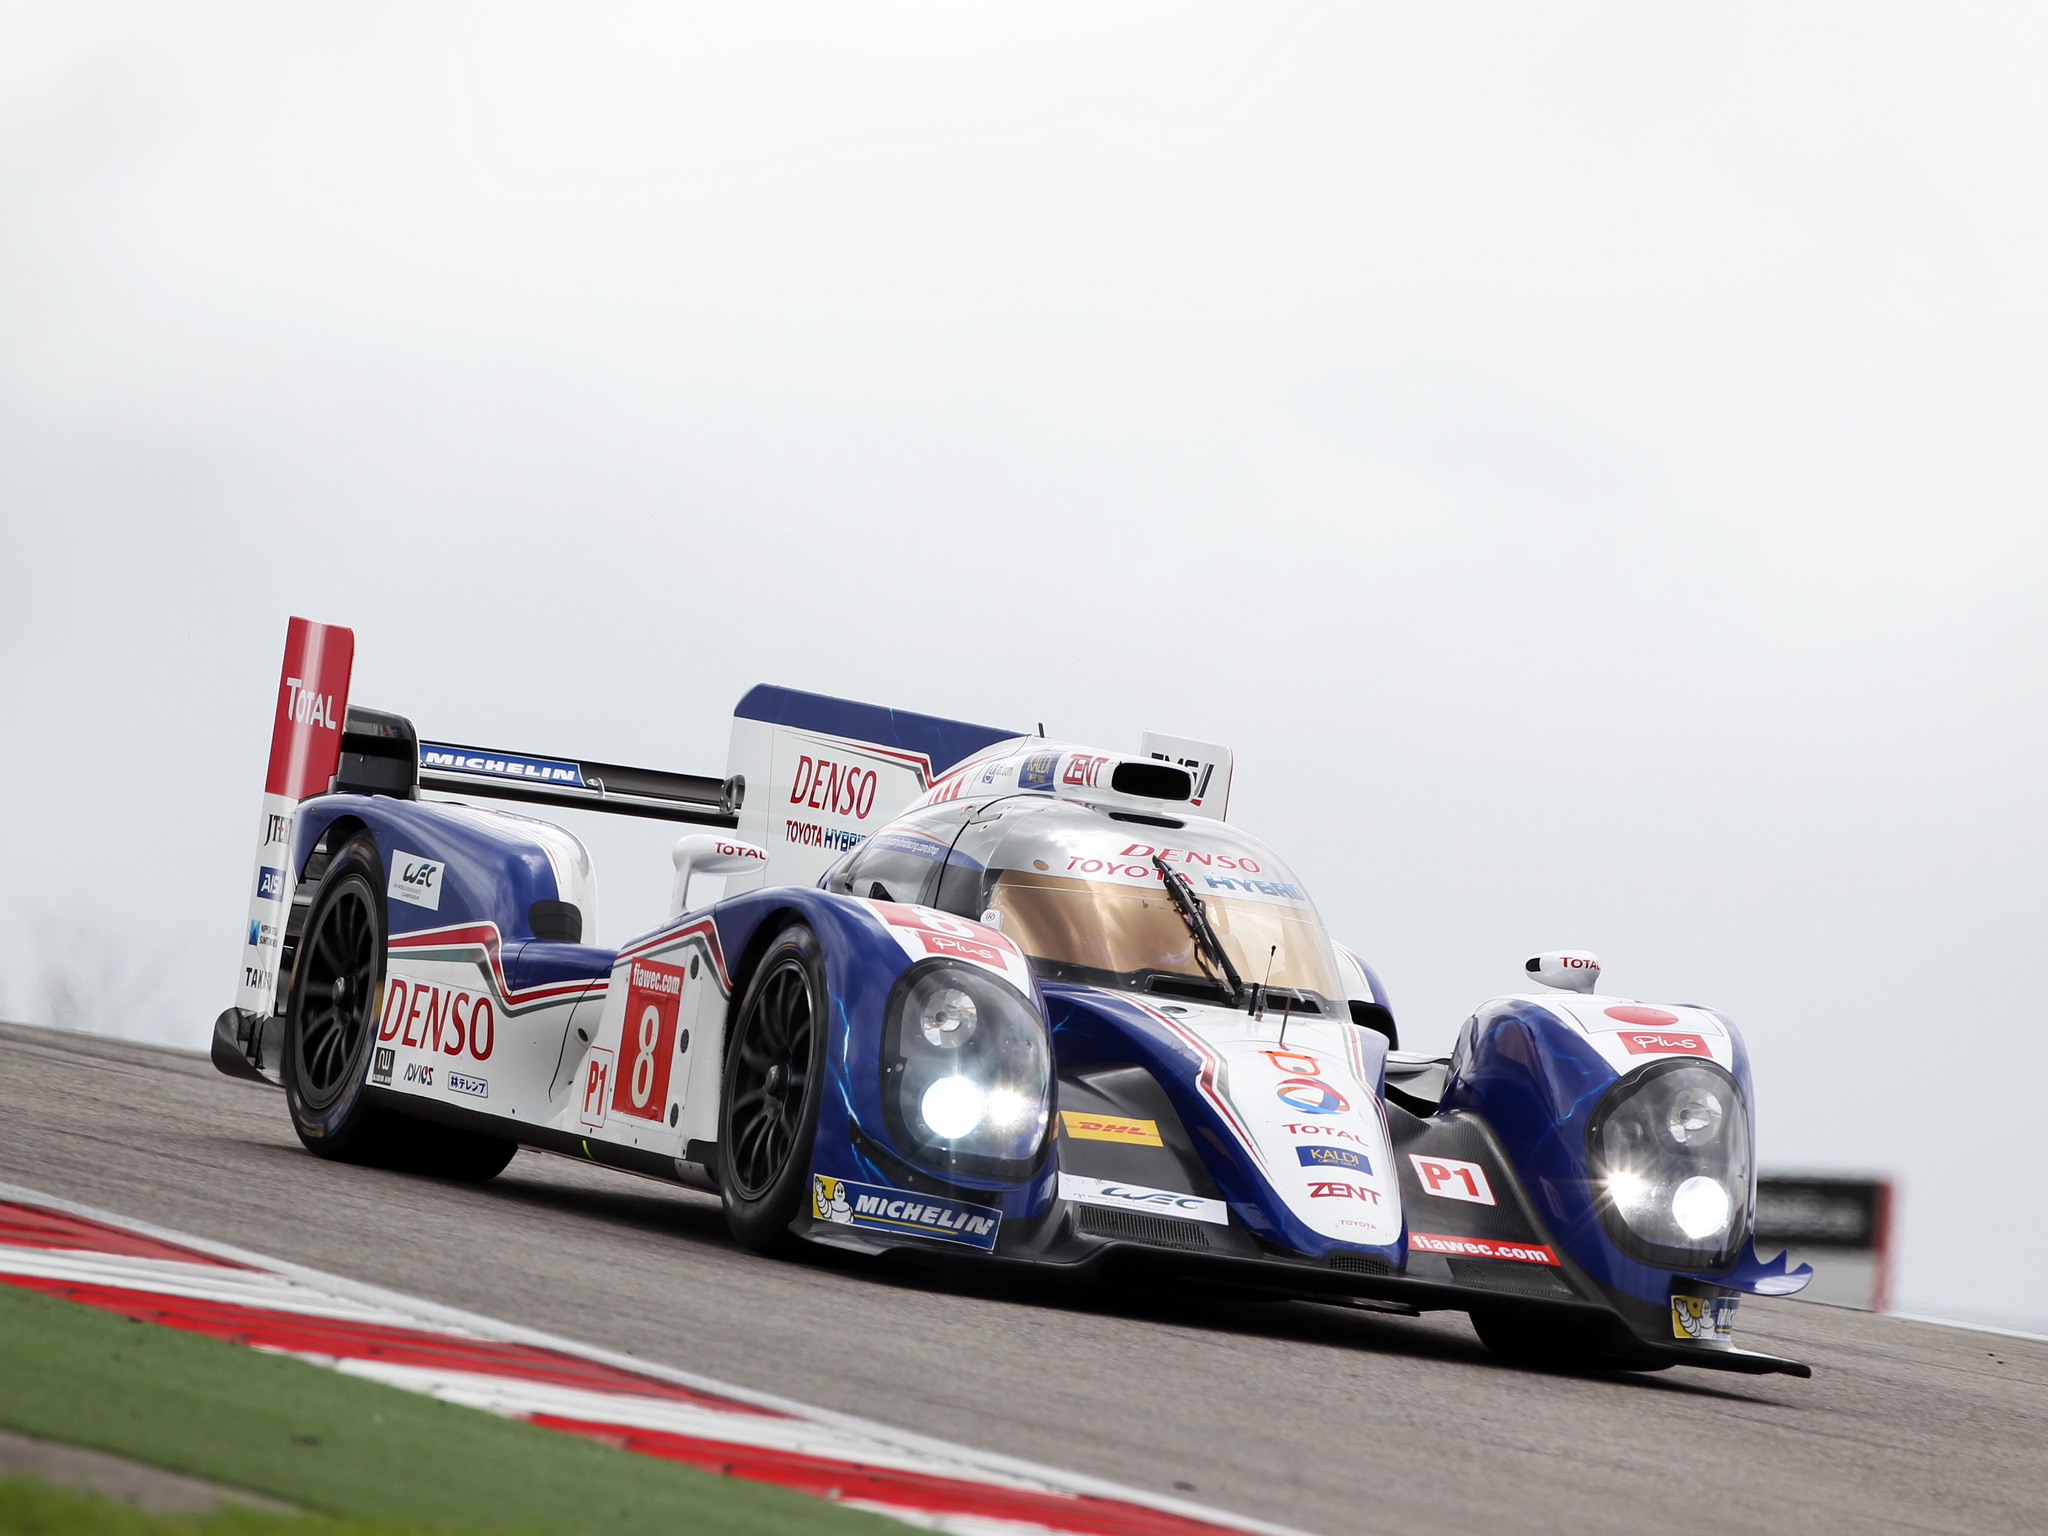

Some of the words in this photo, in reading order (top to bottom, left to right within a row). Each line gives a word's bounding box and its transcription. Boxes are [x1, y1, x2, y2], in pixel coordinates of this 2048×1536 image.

[286, 676, 337, 730] TOTAL
[425, 751, 575, 782] MICHELIN
[1063, 754, 1110, 788] ZENT
[789, 754, 878, 820] DENSO
[785, 819, 823, 848] TOYOTA
[823, 827, 867, 852] HYBR
[715, 841, 767, 861] TOTAL
[1119, 843, 1262, 875] DENSO
[402, 862, 437, 888] WEC
[1203, 875, 1307, 902] HYBRID
[911, 907, 976, 939] 8
[932, 937, 994, 960] Plus
[1559, 956, 1600, 971] TOTAL
[632, 963, 681, 995] fiawec.com
[378, 978, 495, 1061] DENSO
[631, 1004, 660, 1109] 8
[1632, 1034, 1697, 1050] Plus
[583, 1060, 608, 1116] P1
[1078, 1121, 1148, 1136] DHL
[1282, 1123, 1370, 1148] TOTAL
[1310, 1148, 1360, 1165] KALDI
[1307, 1182, 1381, 1206] ZENT
[1419, 1161, 1480, 1198] P1
[1101, 1186, 1204, 1210] WEC
[855, 1194, 996, 1236] MICHELIN
[1339, 1219, 1378, 1231] TOYOTA
[1412, 1235, 1550, 1263] fiawec.com
